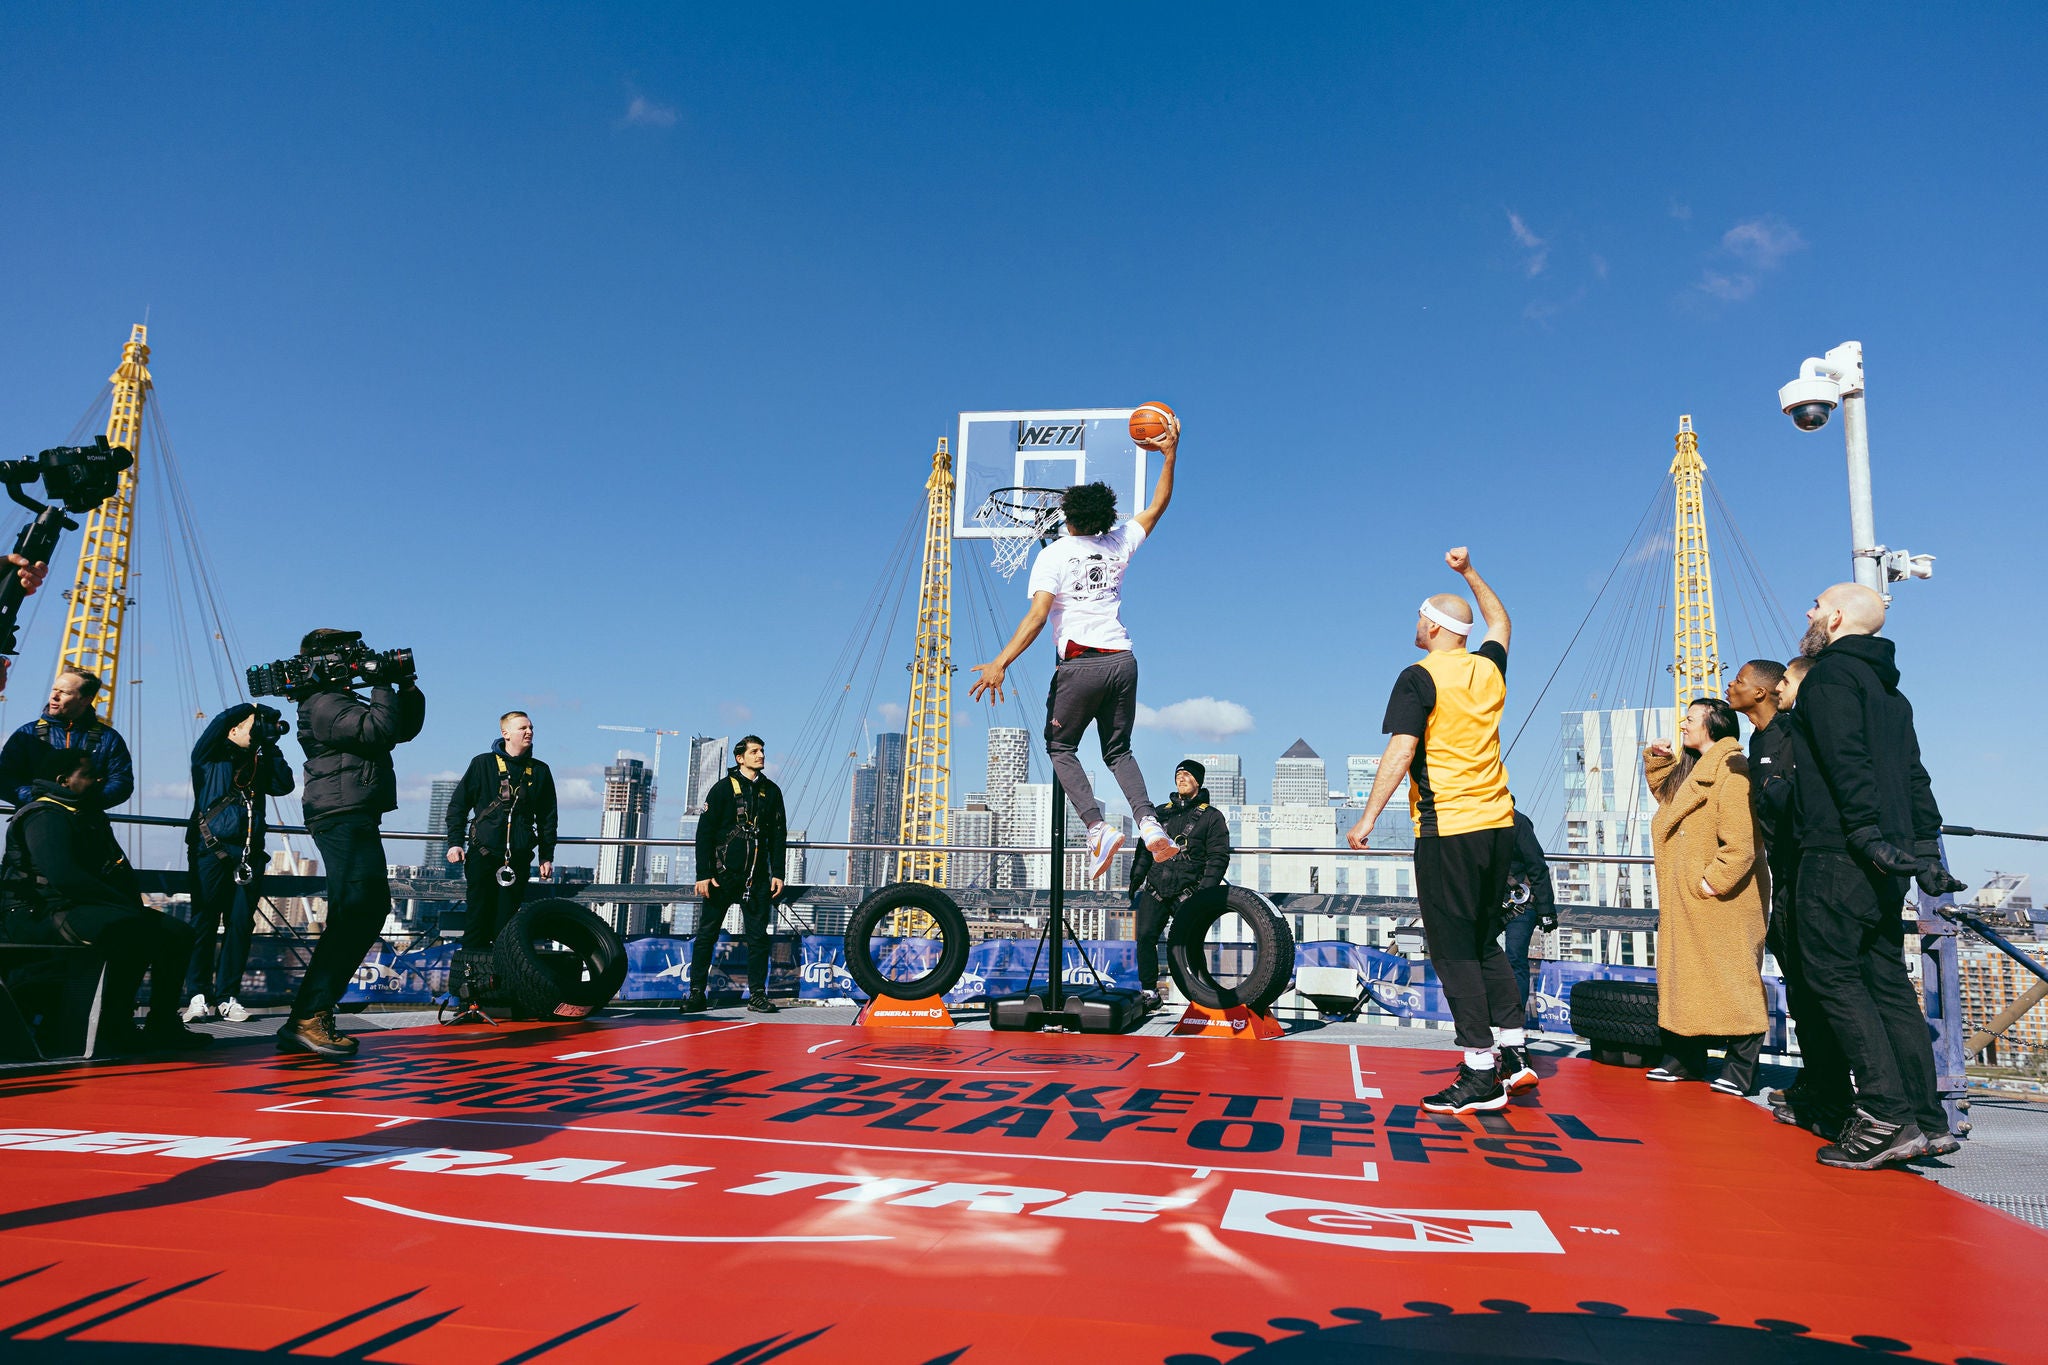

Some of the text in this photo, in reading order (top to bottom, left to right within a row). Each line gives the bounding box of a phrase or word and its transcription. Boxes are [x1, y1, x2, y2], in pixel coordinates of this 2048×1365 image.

[1203, 756, 1218, 766] citi
[805, 963, 833, 988] up
[1183, 1018, 1215, 1026] GENERAL
[1215, 1019, 1232, 1027] TIRE
[214, 1075, 1583, 1174] LEAGUE PLAY-OFFS
[259, 1054, 1644, 1145] BRITISH BASKETBALL
[0, 1128, 715, 1190] GENERAL
[724, 1170, 1197, 1223] TIRE
